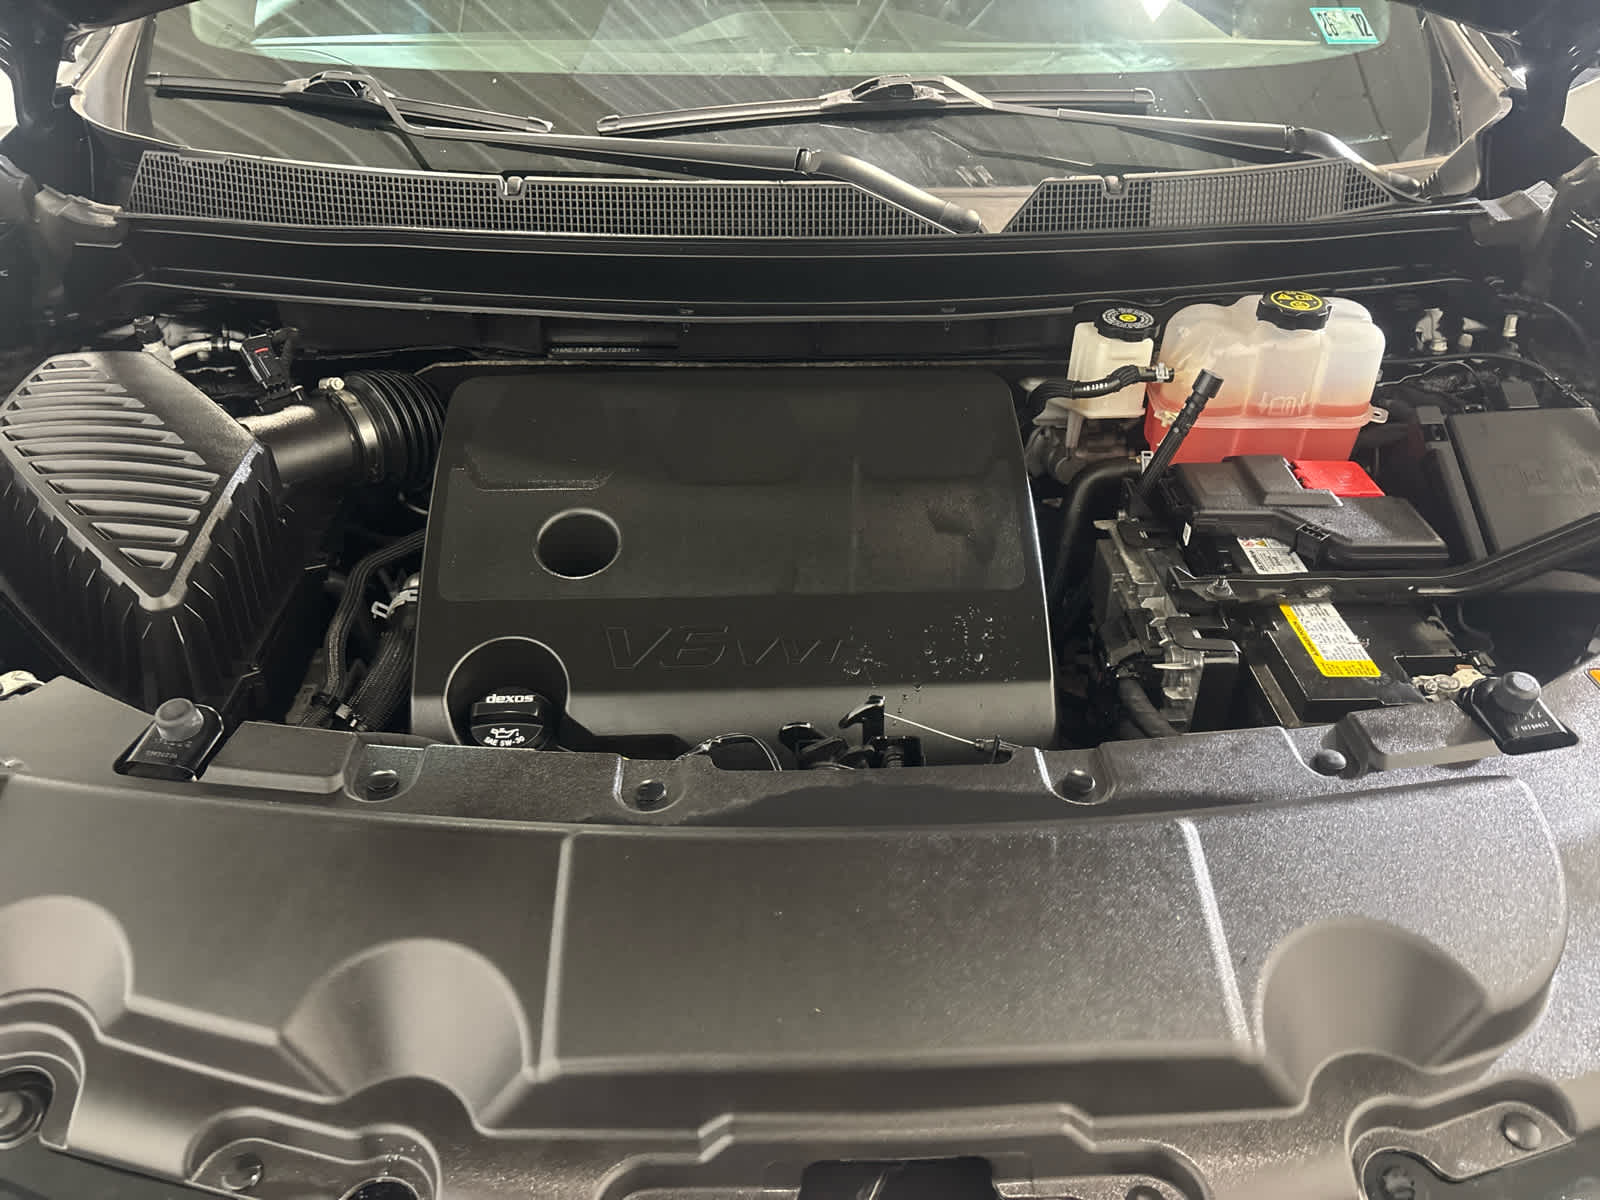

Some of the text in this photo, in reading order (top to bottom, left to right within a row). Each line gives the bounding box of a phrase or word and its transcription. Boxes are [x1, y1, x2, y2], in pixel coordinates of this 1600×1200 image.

[1316, 12, 1373, 37] 26 12
[485, 693, 537, 704] dexos
[483, 736, 498, 747] SAE
